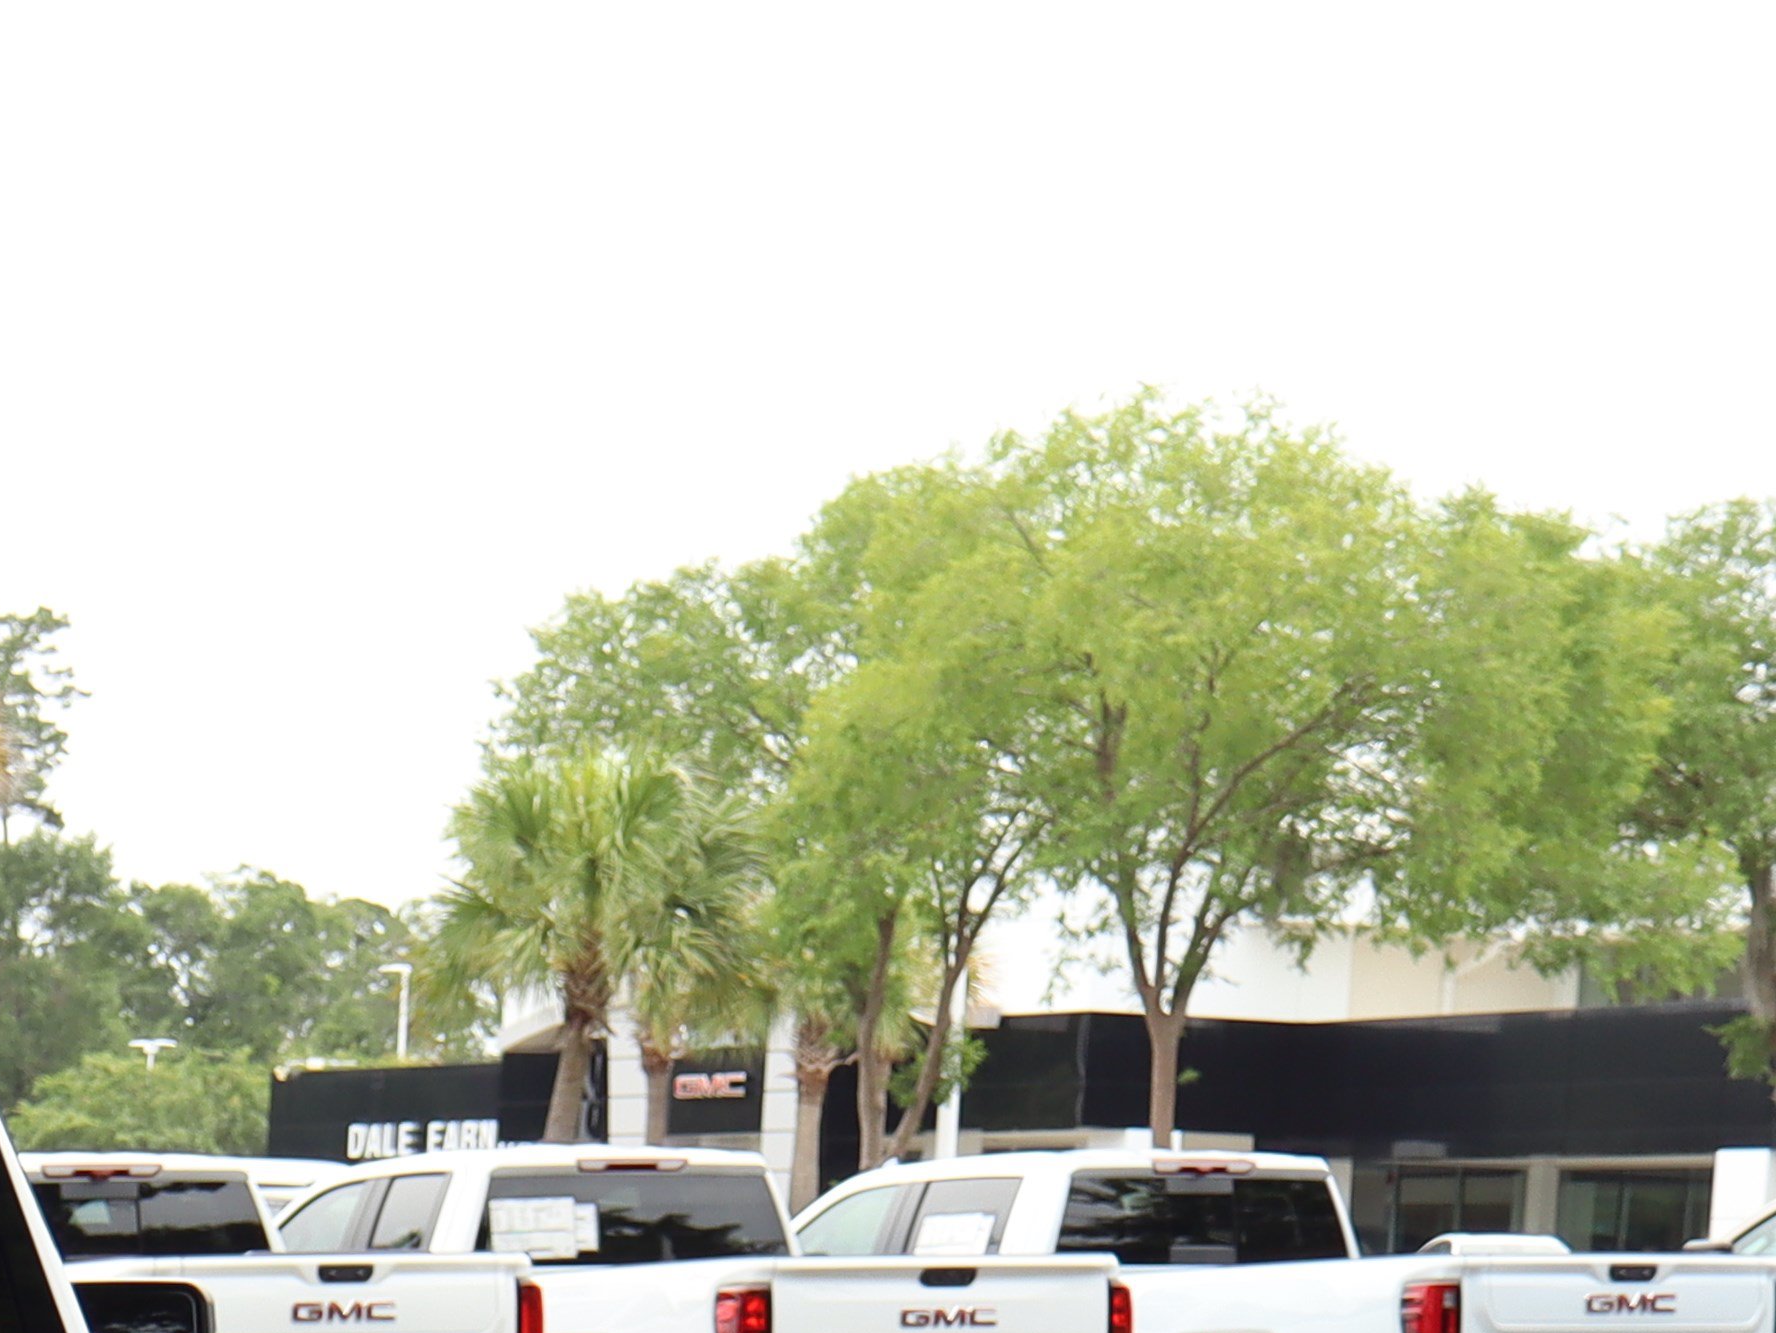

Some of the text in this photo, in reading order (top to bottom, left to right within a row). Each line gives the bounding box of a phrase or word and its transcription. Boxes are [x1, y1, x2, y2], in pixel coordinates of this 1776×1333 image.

[673, 1071, 747, 1100] GMC
[347, 1120, 420, 1160] DALE
[292, 1302, 396, 1323] GMC
[1585, 1292, 1676, 1314] GMC
[899, 1308, 998, 1328] GMC
